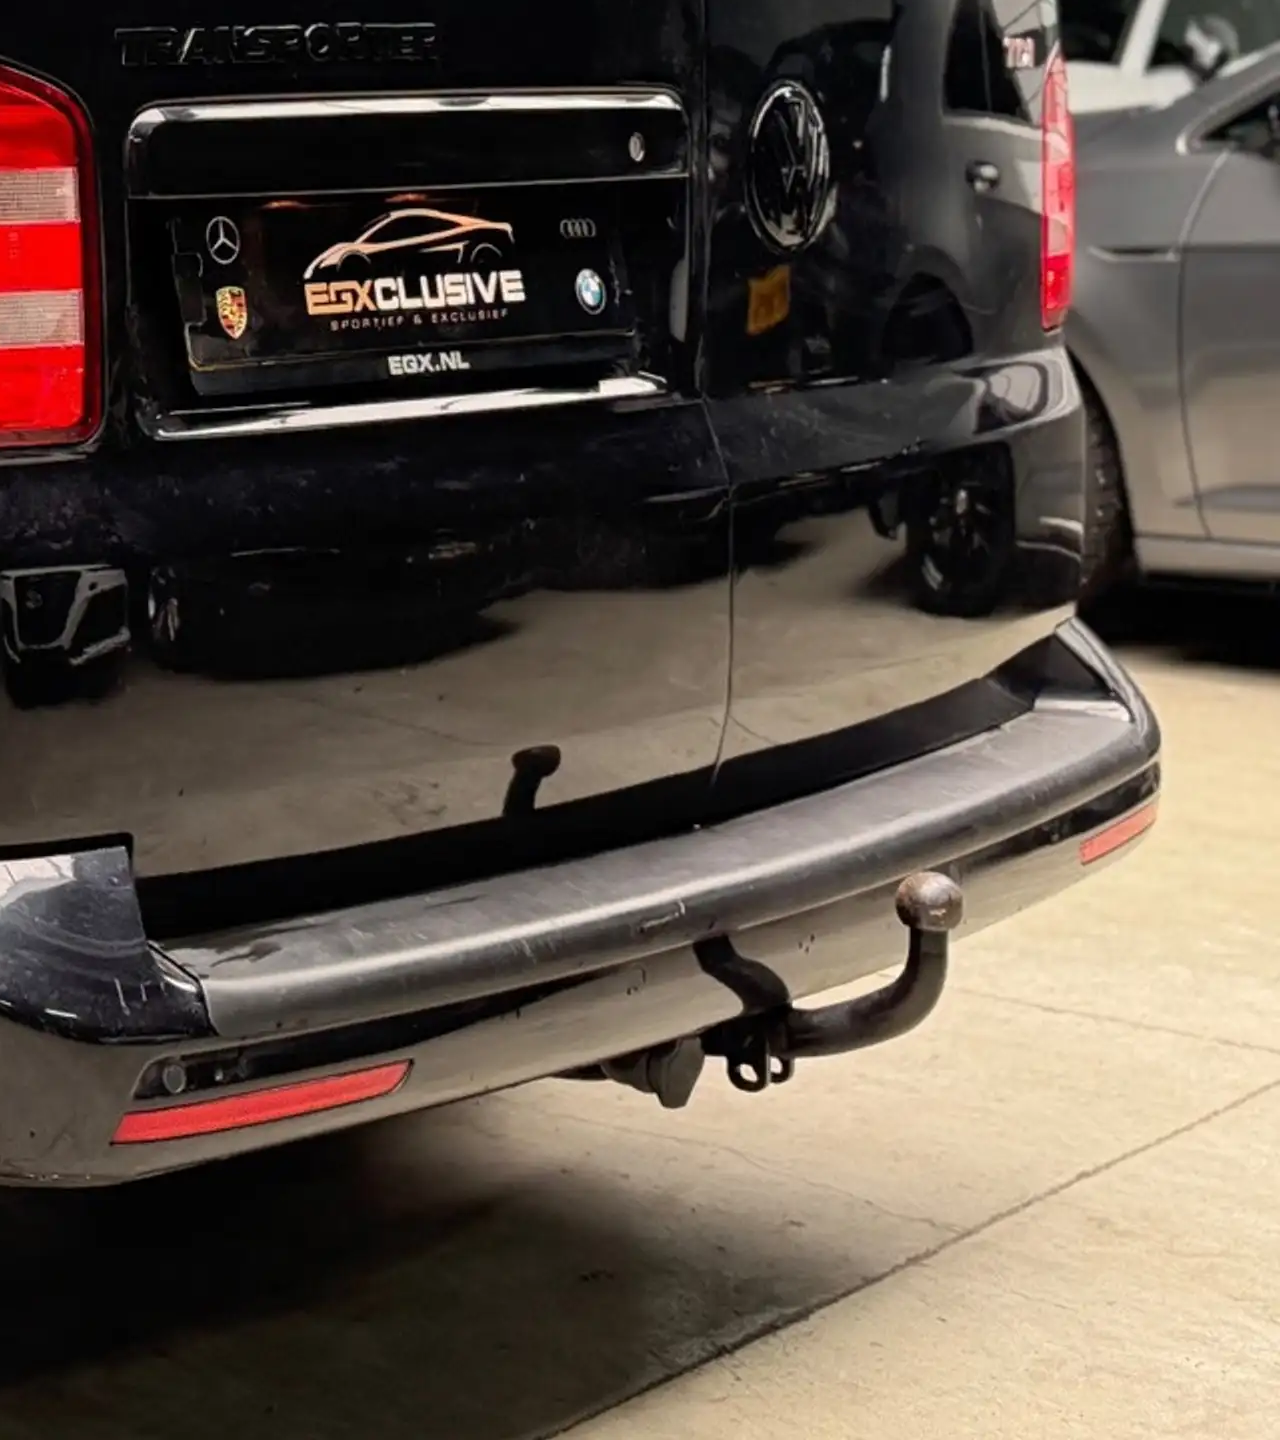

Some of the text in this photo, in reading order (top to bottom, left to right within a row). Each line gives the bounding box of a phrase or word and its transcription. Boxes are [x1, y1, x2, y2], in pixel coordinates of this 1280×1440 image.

[114, 21, 437, 66] TRANSPORTER
[304, 270, 526, 316] EGXCLUSIVE
[387, 350, 471, 375] EGX.NL
